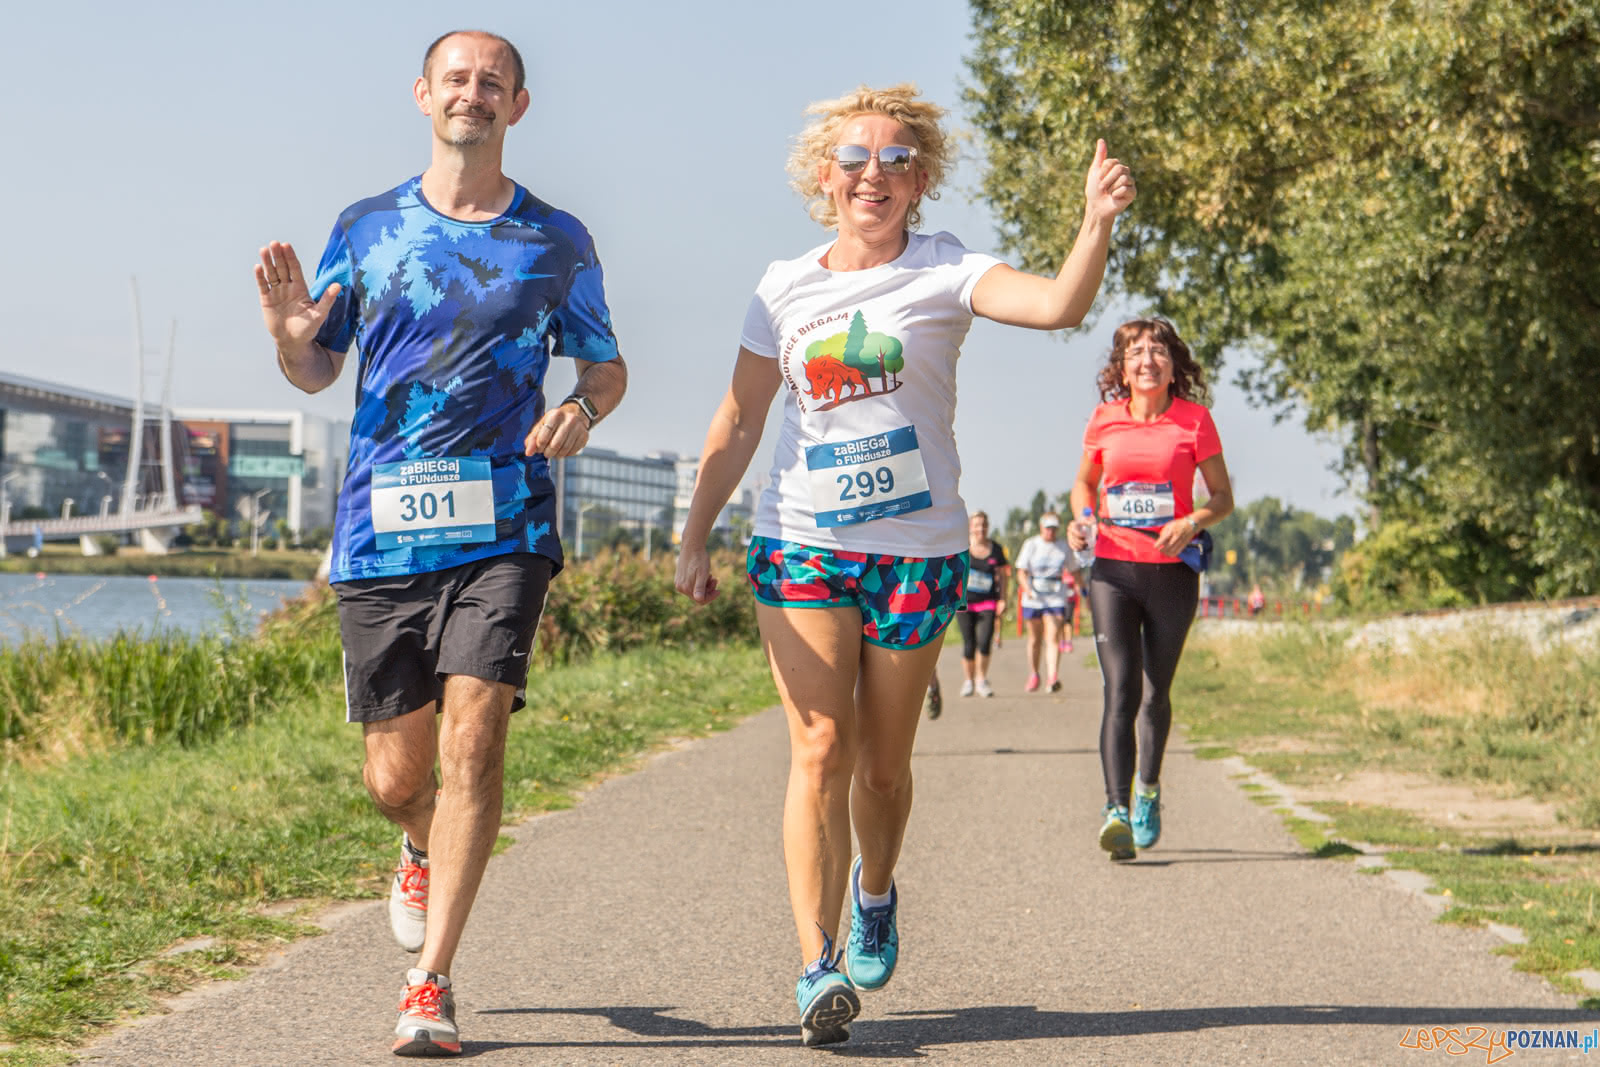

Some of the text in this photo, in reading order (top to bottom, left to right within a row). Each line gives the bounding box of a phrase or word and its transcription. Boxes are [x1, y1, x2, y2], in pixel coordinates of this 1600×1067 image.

[798, 312, 849, 336] BIEGAJĄ
[833, 434, 889, 456] zaBIEGaj
[836, 448, 892, 465] o FUNdusze
[400, 459, 460, 475] zaBIEGaj
[409, 473, 460, 484] FUNdusze
[836, 466, 895, 501] 299
[400, 490, 455, 521] 301
[1122, 499, 1155, 513] 468
